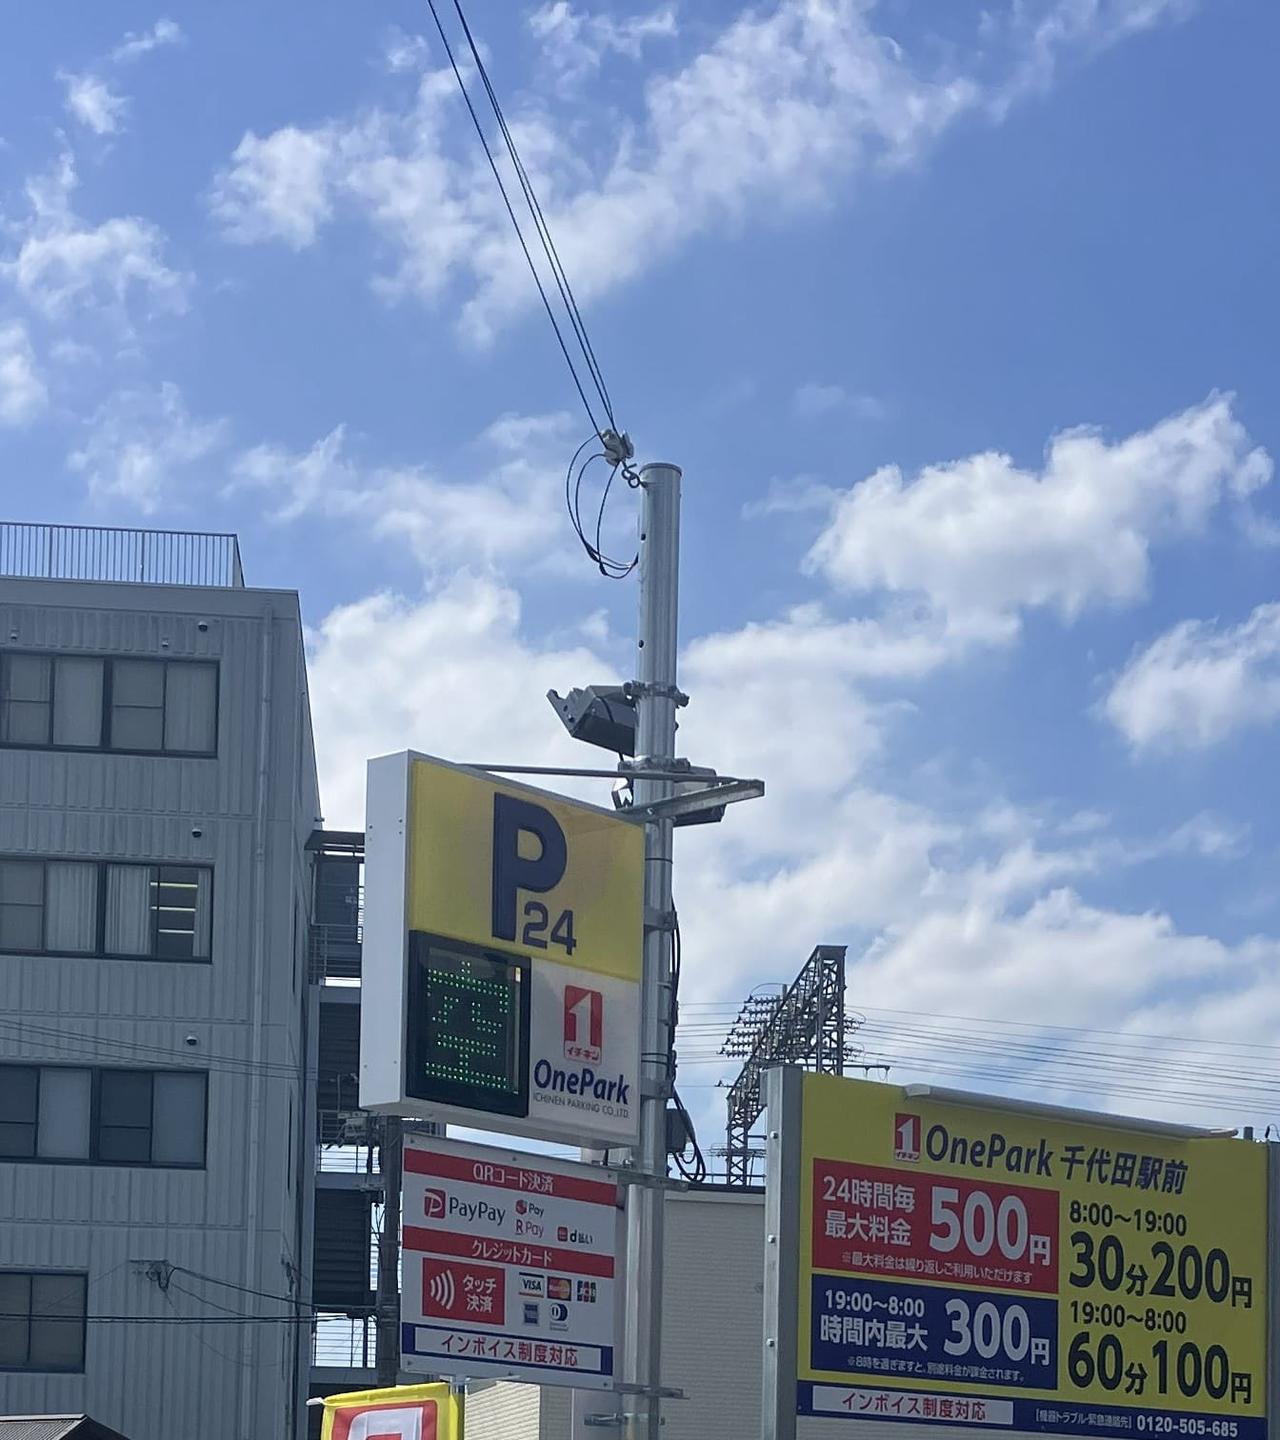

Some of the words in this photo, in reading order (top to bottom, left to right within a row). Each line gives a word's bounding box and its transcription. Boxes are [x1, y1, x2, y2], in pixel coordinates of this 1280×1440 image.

[492, 792, 567, 942] P
[522, 901, 577, 955] 24
[534, 1059, 630, 1105] OnePark
[567, 1098, 601, 1113] PARKING
[926, 1124, 1053, 1177] OnePark
[1060, 1144, 1189, 1195] 千代田駅前
[473, 1162, 554, 1194] QRコード決済
[528, 1202, 544, 1218] Pay
[823, 1176, 915, 1213] 24時間毎
[449, 1197, 506, 1226] PayPay
[929, 1186, 1051, 1266] 500円
[525, 1222, 544, 1238] Pay
[825, 1210, 911, 1247] 最大料金
[472, 1241, 552, 1267] クレジットカード
[463, 1274, 497, 1293] タッチ
[523, 1278, 542, 1293] VISA
[466, 1296, 493, 1313] 決済
[820, 1314, 928, 1351] 時間内最大
[943, 1299, 1051, 1367] 300円
[441, 1334, 578, 1367] インボイス制度対応
[842, 1393, 986, 1420] インボイス制度対応
[1137, 1414, 1238, 1437] 0120-505-685
